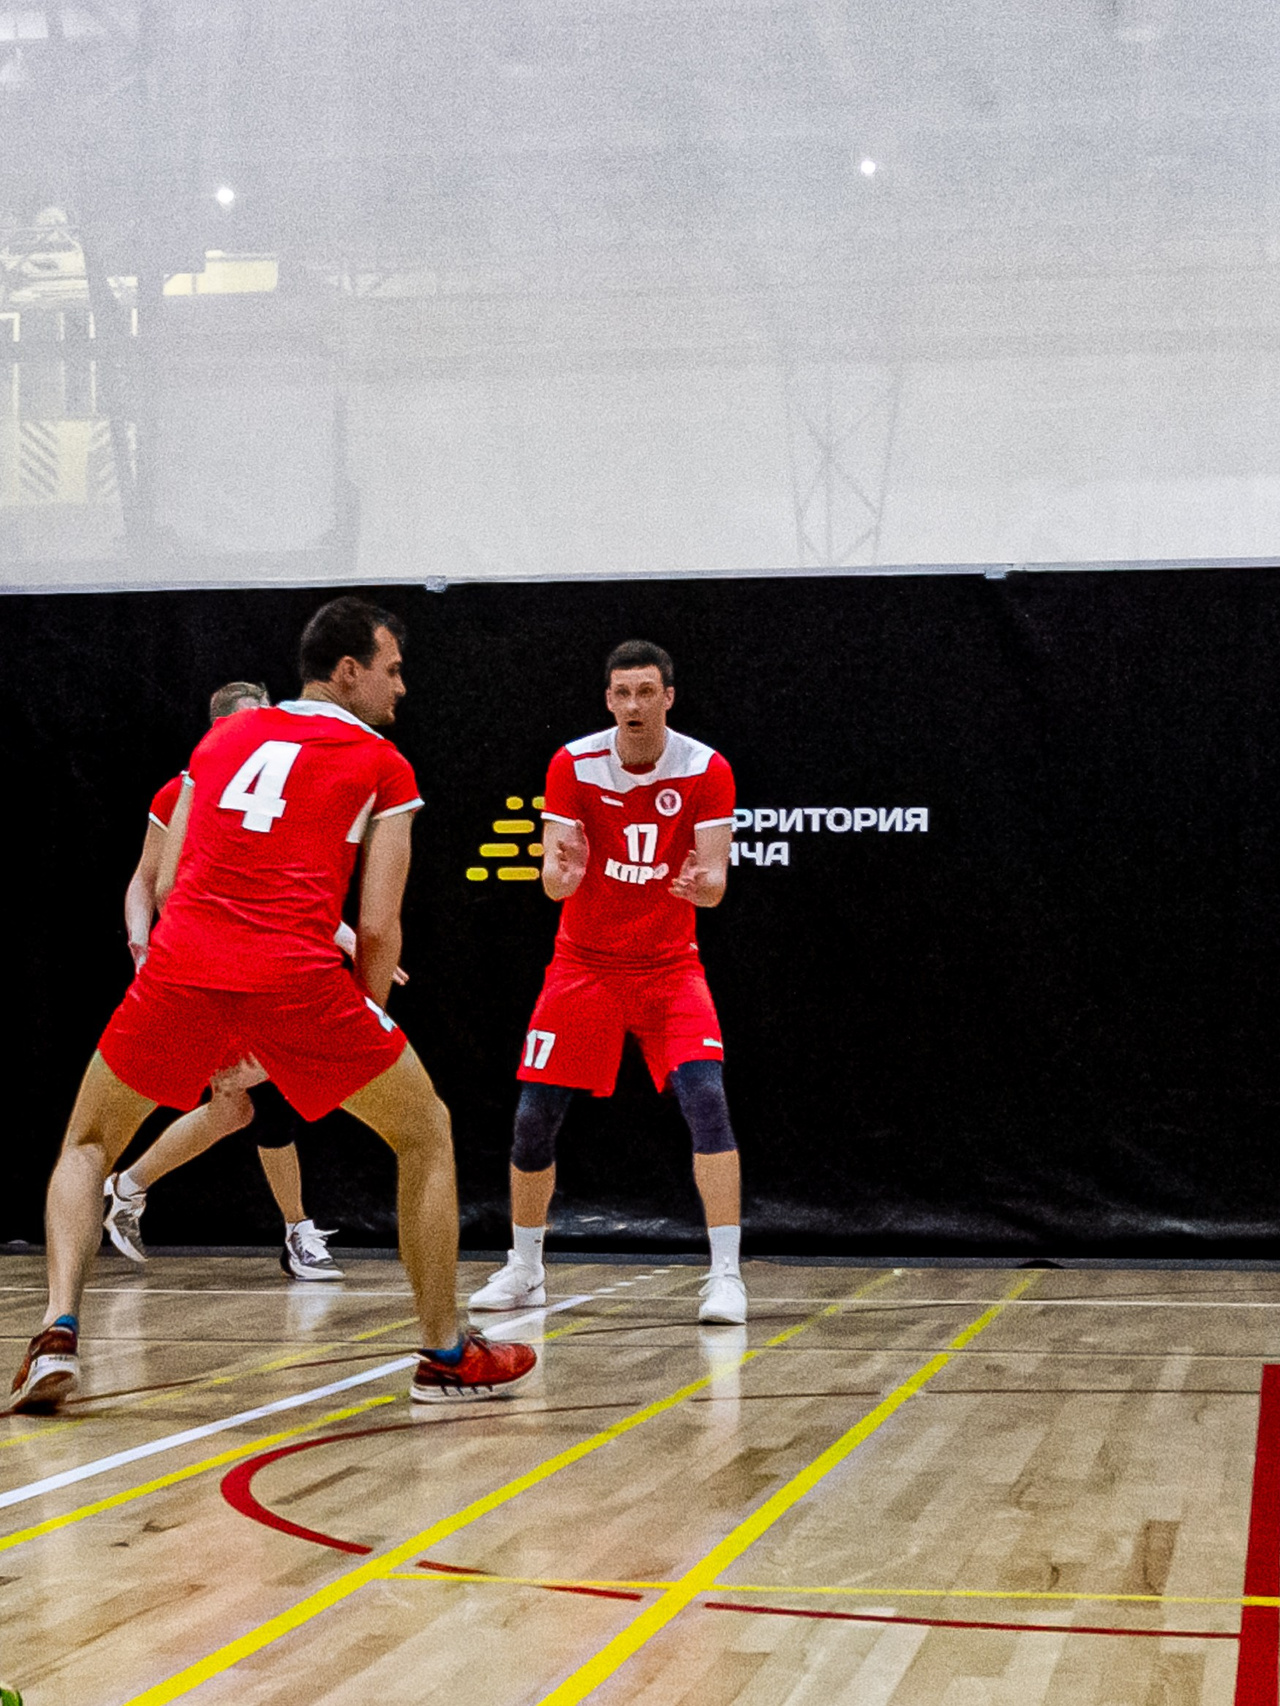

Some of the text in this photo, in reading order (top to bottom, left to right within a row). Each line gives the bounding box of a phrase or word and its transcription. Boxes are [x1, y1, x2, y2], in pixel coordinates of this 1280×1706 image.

[218, 739, 302, 833] 4
[623, 823, 658, 863] 17
[524, 1029, 556, 1070] 17
